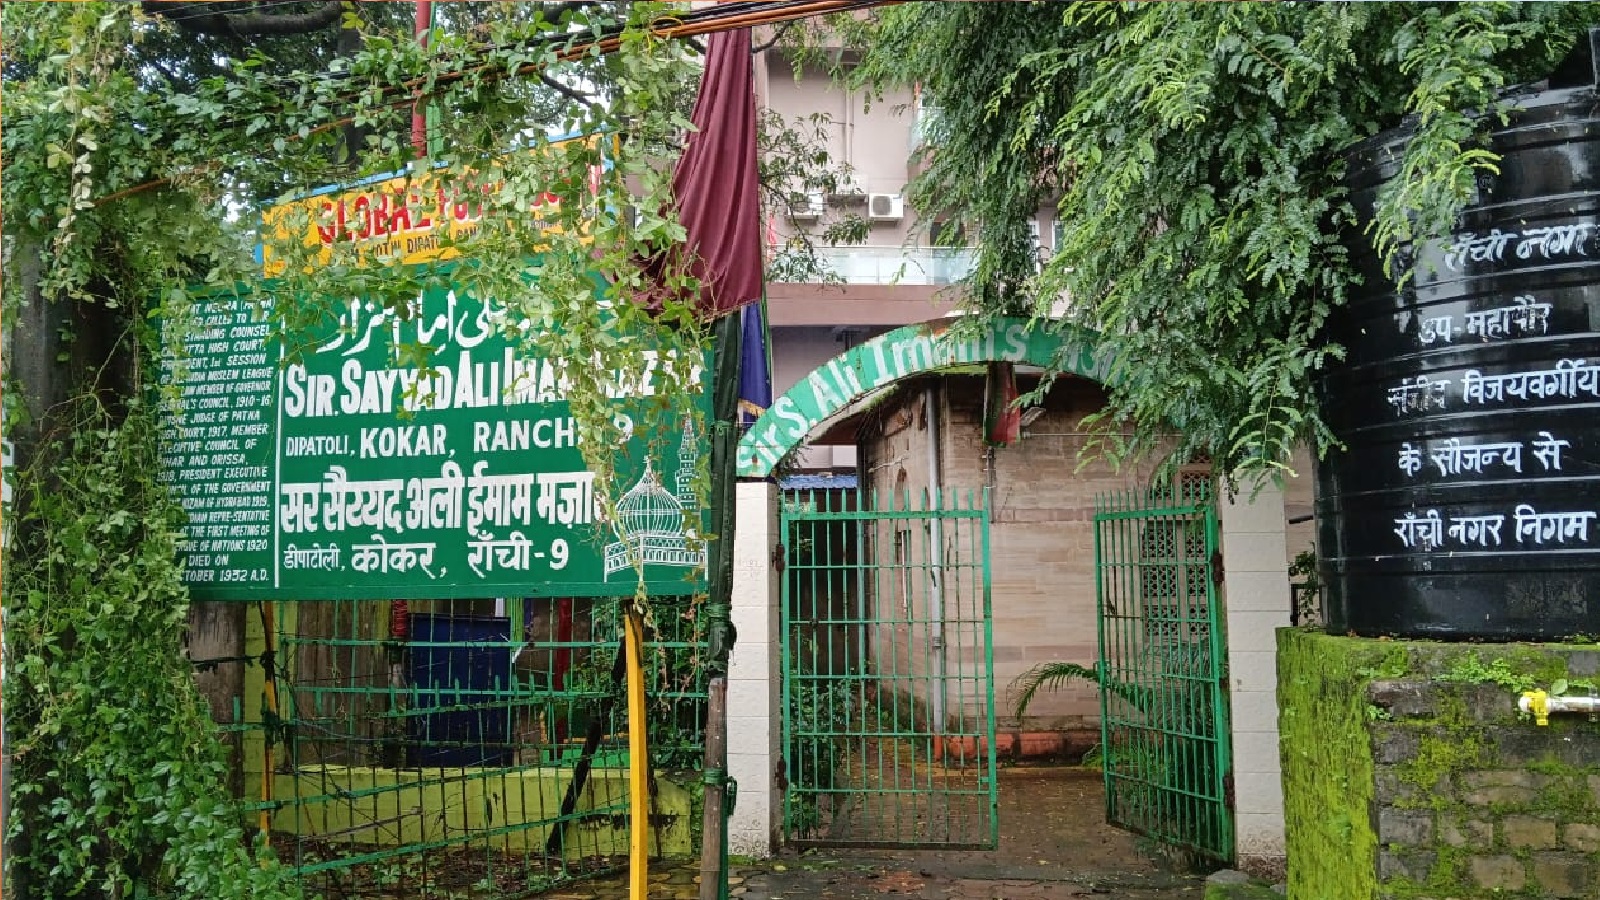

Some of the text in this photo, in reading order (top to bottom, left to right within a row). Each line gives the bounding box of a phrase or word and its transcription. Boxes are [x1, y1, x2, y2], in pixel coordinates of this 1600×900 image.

[236, 313, 246, 323] TO
[231, 324, 270, 338] COUNSEL
[227, 353, 266, 366] SESSION
[808, 352, 862, 418] Ali
[231, 424, 268, 436] MEMBER
[245, 439, 257, 449] OF
[285, 435, 356, 457] DIPATOLI,
[360, 424, 456, 459] KOKAR,
[1532, 431, 1571, 470] से
[189, 455, 208, 465] AND
[179, 468, 222, 481] PRESIDENT
[224, 467, 267, 478] EXECUTIVE
[204, 482, 219, 493] THE
[222, 481, 271, 493] GOVERNMENT
[280, 482, 321, 533] सर
[405, 460, 465, 530] अली
[467, 460, 535, 537] ईमाम
[1448, 514, 1504, 547] नगर
[1513, 504, 1597, 544] निगम
[211, 540, 244, 551] NATIONS
[188, 554, 229, 567] DIED ON
